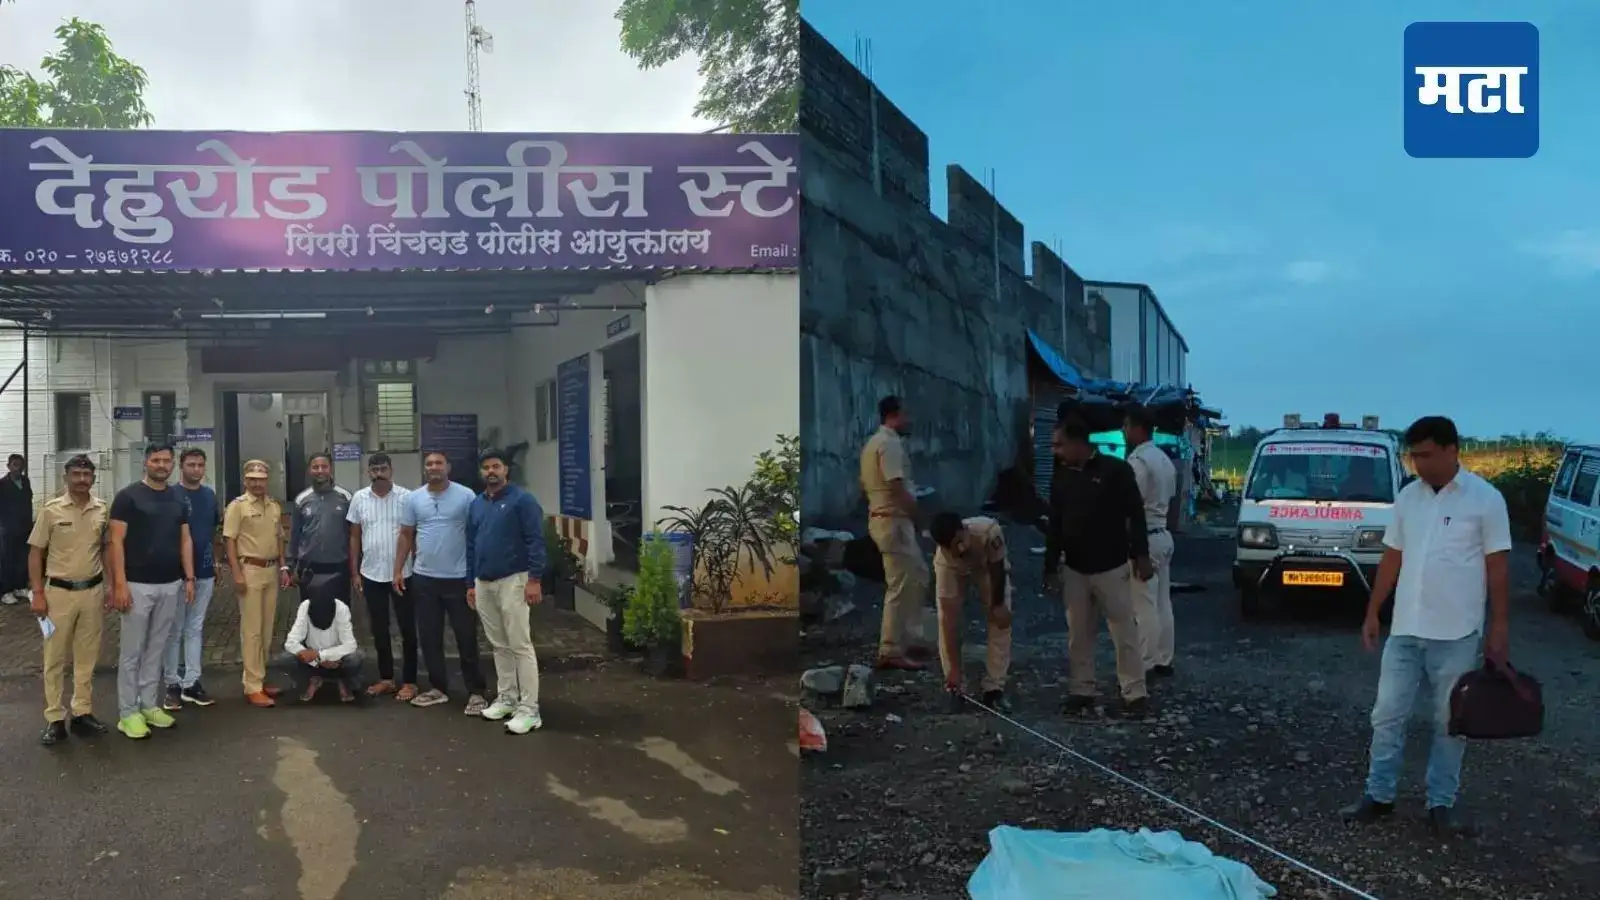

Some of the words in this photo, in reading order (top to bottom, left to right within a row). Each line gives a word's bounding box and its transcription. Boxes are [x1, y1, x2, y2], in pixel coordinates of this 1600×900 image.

[29, 136, 330, 244] देहुरोड
[356, 139, 652, 218] पोलीस
[677, 140, 800, 218] स्टे
[24, 248, 58, 264] ०२०
[85, 248, 174, 265] २७६७१२८८
[285, 223, 360, 257] पिंपरी
[367, 223, 469, 256] चिंचवड
[476, 222, 562, 255] पोलीस
[570, 228, 711, 263] आयुक्तालय
[750, 244, 789, 258] Email
